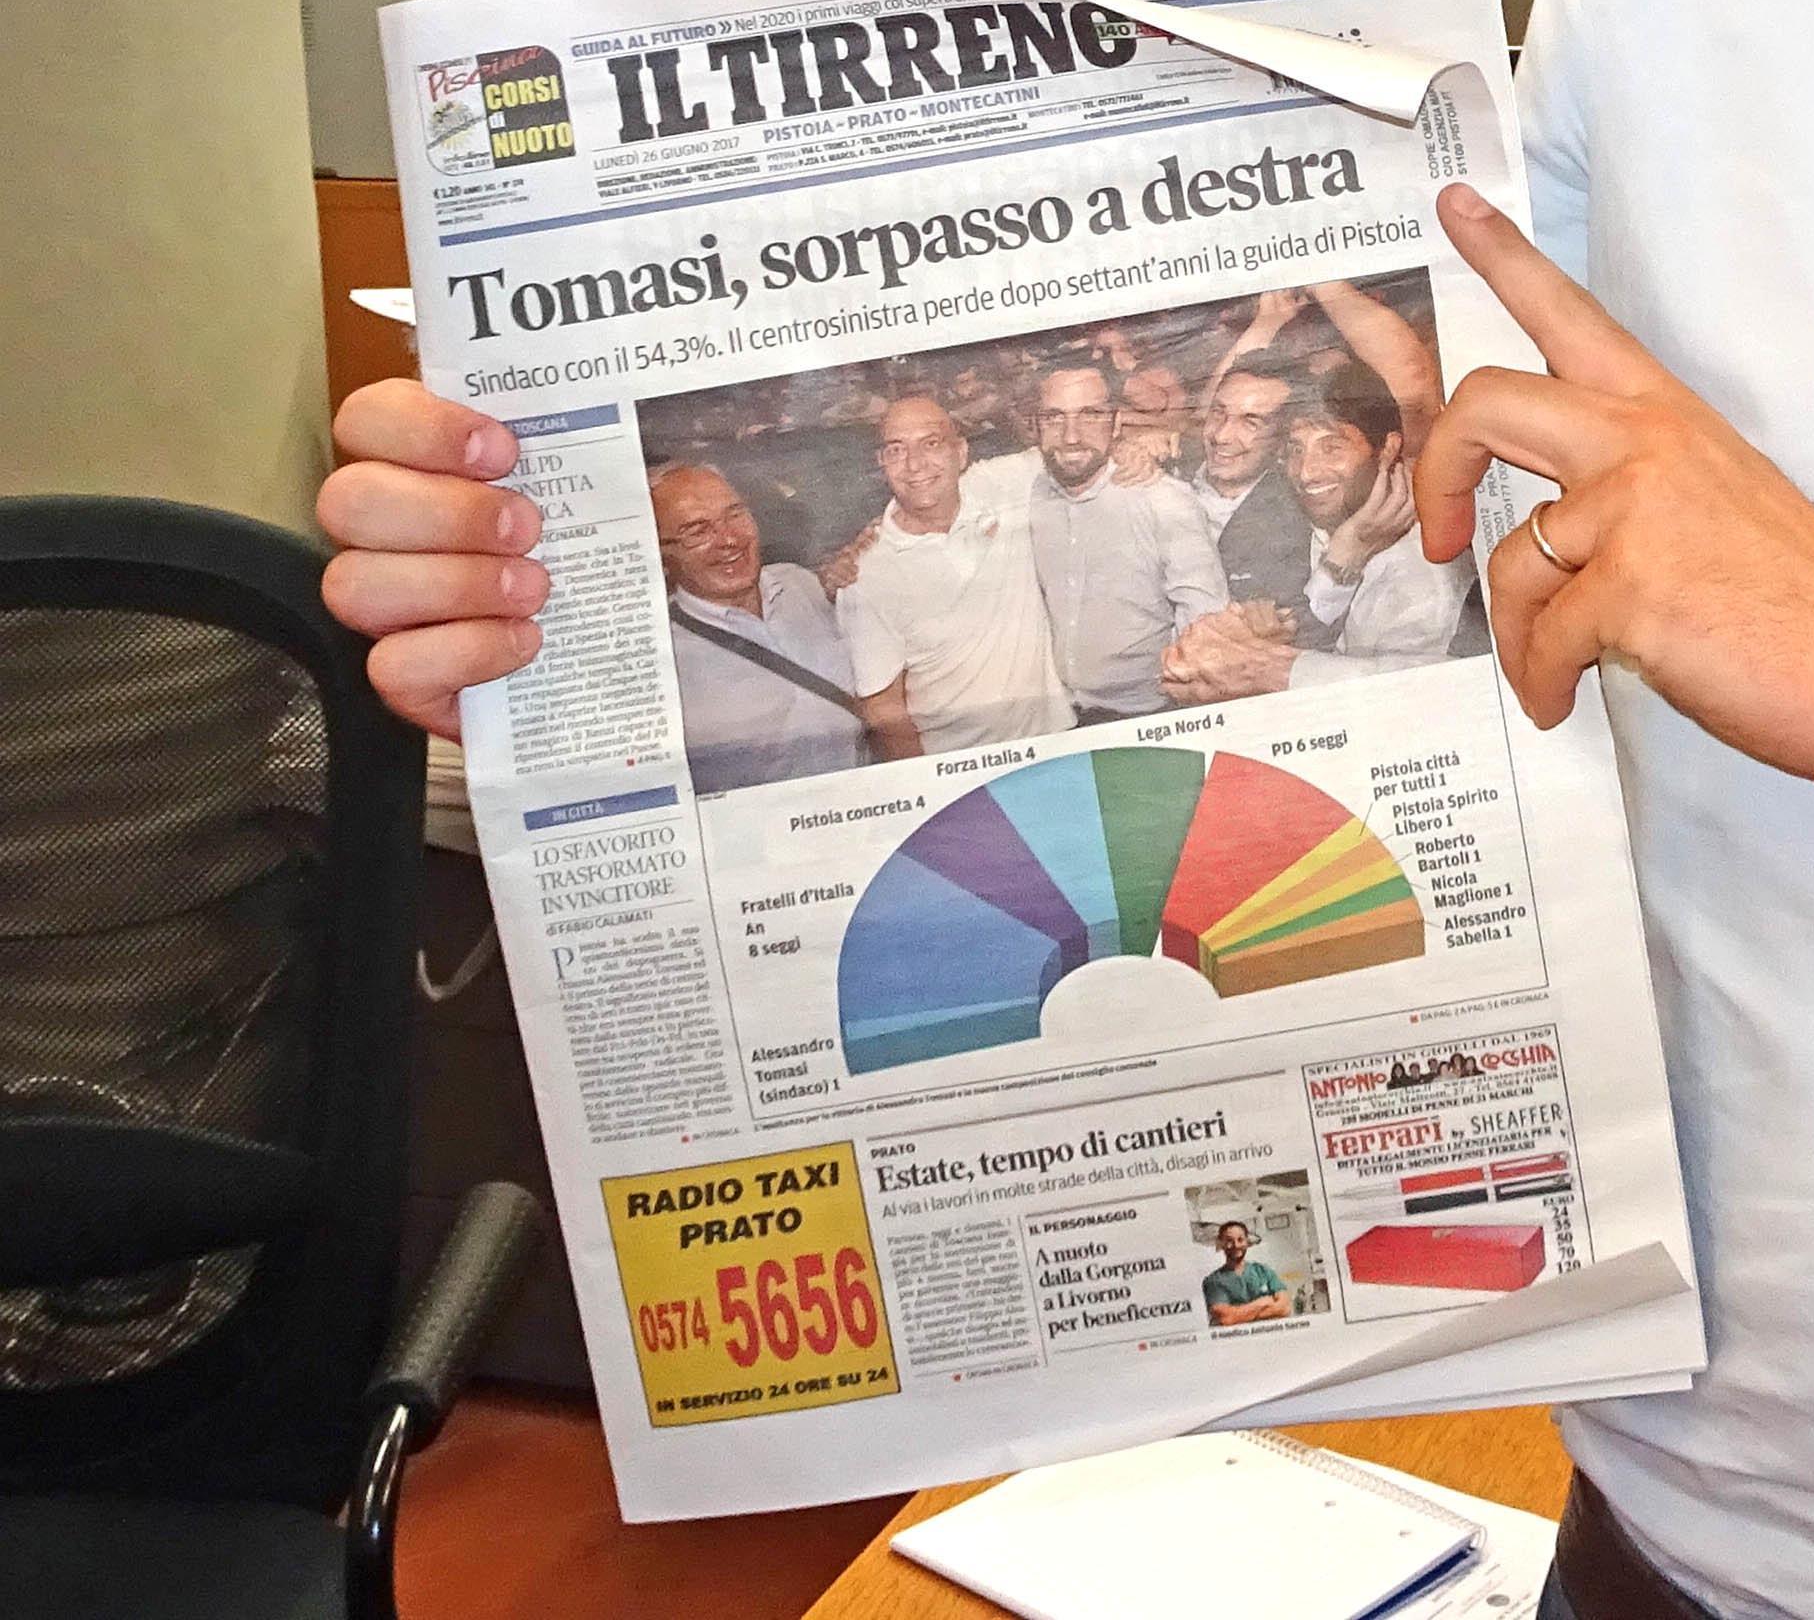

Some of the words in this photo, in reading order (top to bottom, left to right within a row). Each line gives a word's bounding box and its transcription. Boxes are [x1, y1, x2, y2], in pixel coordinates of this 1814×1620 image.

[571, 37, 625, 58] GUIDA
[628, 32, 648, 49] AL
[651, 25, 716, 45] FUTURO
[735, 19, 756, 32] Nel
[761, 12, 795, 28] 2020
[798, 10, 802, 23] i
[805, 5, 837, 23] primi
[606, 47, 710, 144] IL
[707, 1, 1137, 126] TIRRENO
[485, 75, 561, 110] CORSI
[763, 121, 834, 144] PISTOIA
[848, 107, 907, 129] PRATO
[921, 85, 1041, 119] MONTECATINI
[1445, 102, 1461, 140] PISTOIA
[492, 122, 574, 159] NUOTO
[1433, 107, 1450, 153] AGENZIA
[594, 150, 640, 171] LUNEDÌ
[643, 151, 658, 163] 26
[661, 142, 709, 159] GIUGNO
[712, 137, 741, 151] 2017
[1425, 142, 1439, 179] COPIE
[1454, 143, 1467, 175] 51100
[448, 232, 750, 341] Tomasi,
[760, 193, 1075, 290] sorpasso
[1087, 185, 1132, 237] a
[1142, 145, 1364, 226] destra
[464, 363, 560, 398] Sindaco
[565, 352, 611, 383] con
[614, 345, 631, 374] il
[634, 334, 724, 370] 54,3%.
[728, 328, 744, 354] Il
[749, 300, 919, 351] centrosinistra
[922, 287, 995, 326] perde
[999, 276, 1063, 314] dopo
[1066, 247, 1211, 297] settant'anni
[1214, 243, 1238, 270] la
[1243, 233, 1311, 271] guida
[1315, 224, 1339, 255] di
[1342, 213, 1422, 250] Pistoia
[537, 455, 563, 473] PD
[1137, 726, 1172, 742] Lega
[1175, 715, 1212, 733] Nord
[1215, 713, 1225, 727] 4
[1271, 741, 1293, 757] PD
[1296, 739, 1306, 752] 6
[1310, 729, 1348, 750] seggi
[936, 753, 979, 777] Forza
[981, 748, 1022, 769] Italia
[1024, 746, 1036, 761] 4
[1370, 760, 1423, 780] Pistoia
[1426, 750, 1461, 771] città
[1373, 782, 1397, 801] per
[1401, 774, 1435, 793] tutti
[1439, 773, 1447, 786] 1
[789, 810, 843, 832] Pistoia
[846, 799, 911, 822] concreta
[915, 795, 926, 809] 4
[1392, 797, 1445, 818] Pistoia
[1448, 788, 1498, 810] Spirito
[1395, 817, 1443, 837] Libero
[1446, 814, 1454, 827] 1
[533, 847, 560, 867] LO
[562, 827, 675, 862] SFAVORITO
[1415, 833, 1475, 855] Roberto
[536, 850, 686, 891] TRASFORMATO
[1418, 852, 1469, 873] Bartoli
[1473, 850, 1482, 863] 1
[541, 896, 564, 915] IN
[564, 876, 675, 912] VINCITORE
[1431, 872, 1478, 891] Nicola
[1434, 885, 1502, 909] Maglione
[1504, 883, 1513, 896] 1
[740, 890, 796, 915] Fratelli
[1444, 904, 1526, 931] Alessandro
[559, 919, 594, 934] FABIO
[595, 911, 653, 928] CALAMATI
[745, 921, 765, 936] An
[1445, 928, 1502, 948] Sabella
[1504, 925, 1513, 937] 1
[749, 943, 759, 957] 8
[762, 937, 801, 957] seggi
[751, 1037, 835, 1063] Alessandro
[1309, 1055, 1396, 1075] SPECIALISTI
[1402, 1051, 1415, 1060] IN
[1421, 1040, 1486, 1057] GIOIELLI
[1492, 1034, 1516, 1046] DAL
[1525, 1029, 1551, 1040] 1969
[755, 1062, 809, 1083] Tomasi
[1310, 1072, 1387, 1100] ANTONIO
[759, 1080, 829, 1105] (sindaco)
[832, 1079, 840, 1090] 1
[1322, 1114, 1444, 1160] Ferrari
[1471, 1103, 1564, 1136] SHEAFFER
[869, 1141, 917, 1160] PRATO
[874, 1156, 976, 1194] Estate,
[979, 1140, 1076, 1179] tempo
[1080, 1131, 1109, 1157] di
[1114, 1110, 1228, 1154] cantieri
[1488, 1141, 1536, 1157] FERRARI
[626, 1178, 744, 1218] RADIO
[755, 1161, 840, 1198] TAXI
[881, 1202, 899, 1219] Al
[900, 1197, 922, 1216] via
[931, 1188, 973, 1211] lavori
[975, 1185, 990, 1205] in
[992, 1180, 1036, 1203] molte
[1038, 1171, 1086, 1196] strade
[1088, 1166, 1125, 1188] della
[1127, 1157, 1165, 1181] città,
[1167, 1151, 1211, 1178] disagi
[1211, 1148, 1227, 1167] in
[1229, 1141, 1274, 1164] arrivo
[1029, 1224, 1041, 1238] IL
[1043, 1208, 1137, 1235] PERSONAGGIO
[1553, 1206, 1568, 1219] 24
[680, 1206, 802, 1250] PRATO
[1035, 1247, 1050, 1267] A
[1053, 1241, 1108, 1263] nuoto
[1557, 1260, 1581, 1274] 120
[1559, 1246, 1575, 1259] 70
[1038, 1268, 1083, 1289] dalla
[1086, 1256, 1166, 1285] Gorgona
[638, 1296, 710, 1354] 0574
[715, 1246, 878, 1368] 5656
[1043, 1296, 1053, 1312] a
[1057, 1284, 1132, 1309] Livorno
[1047, 1313, 1078, 1340] per
[1081, 1297, 1193, 1329] beneficenza
[656, 1399, 675, 1414] IN
[679, 1384, 764, 1412] SERVIZIO
[768, 1383, 789, 1400] 24
[794, 1376, 832, 1394] ORE
[837, 1372, 862, 1387] SU
[866, 1366, 889, 1381] 24
